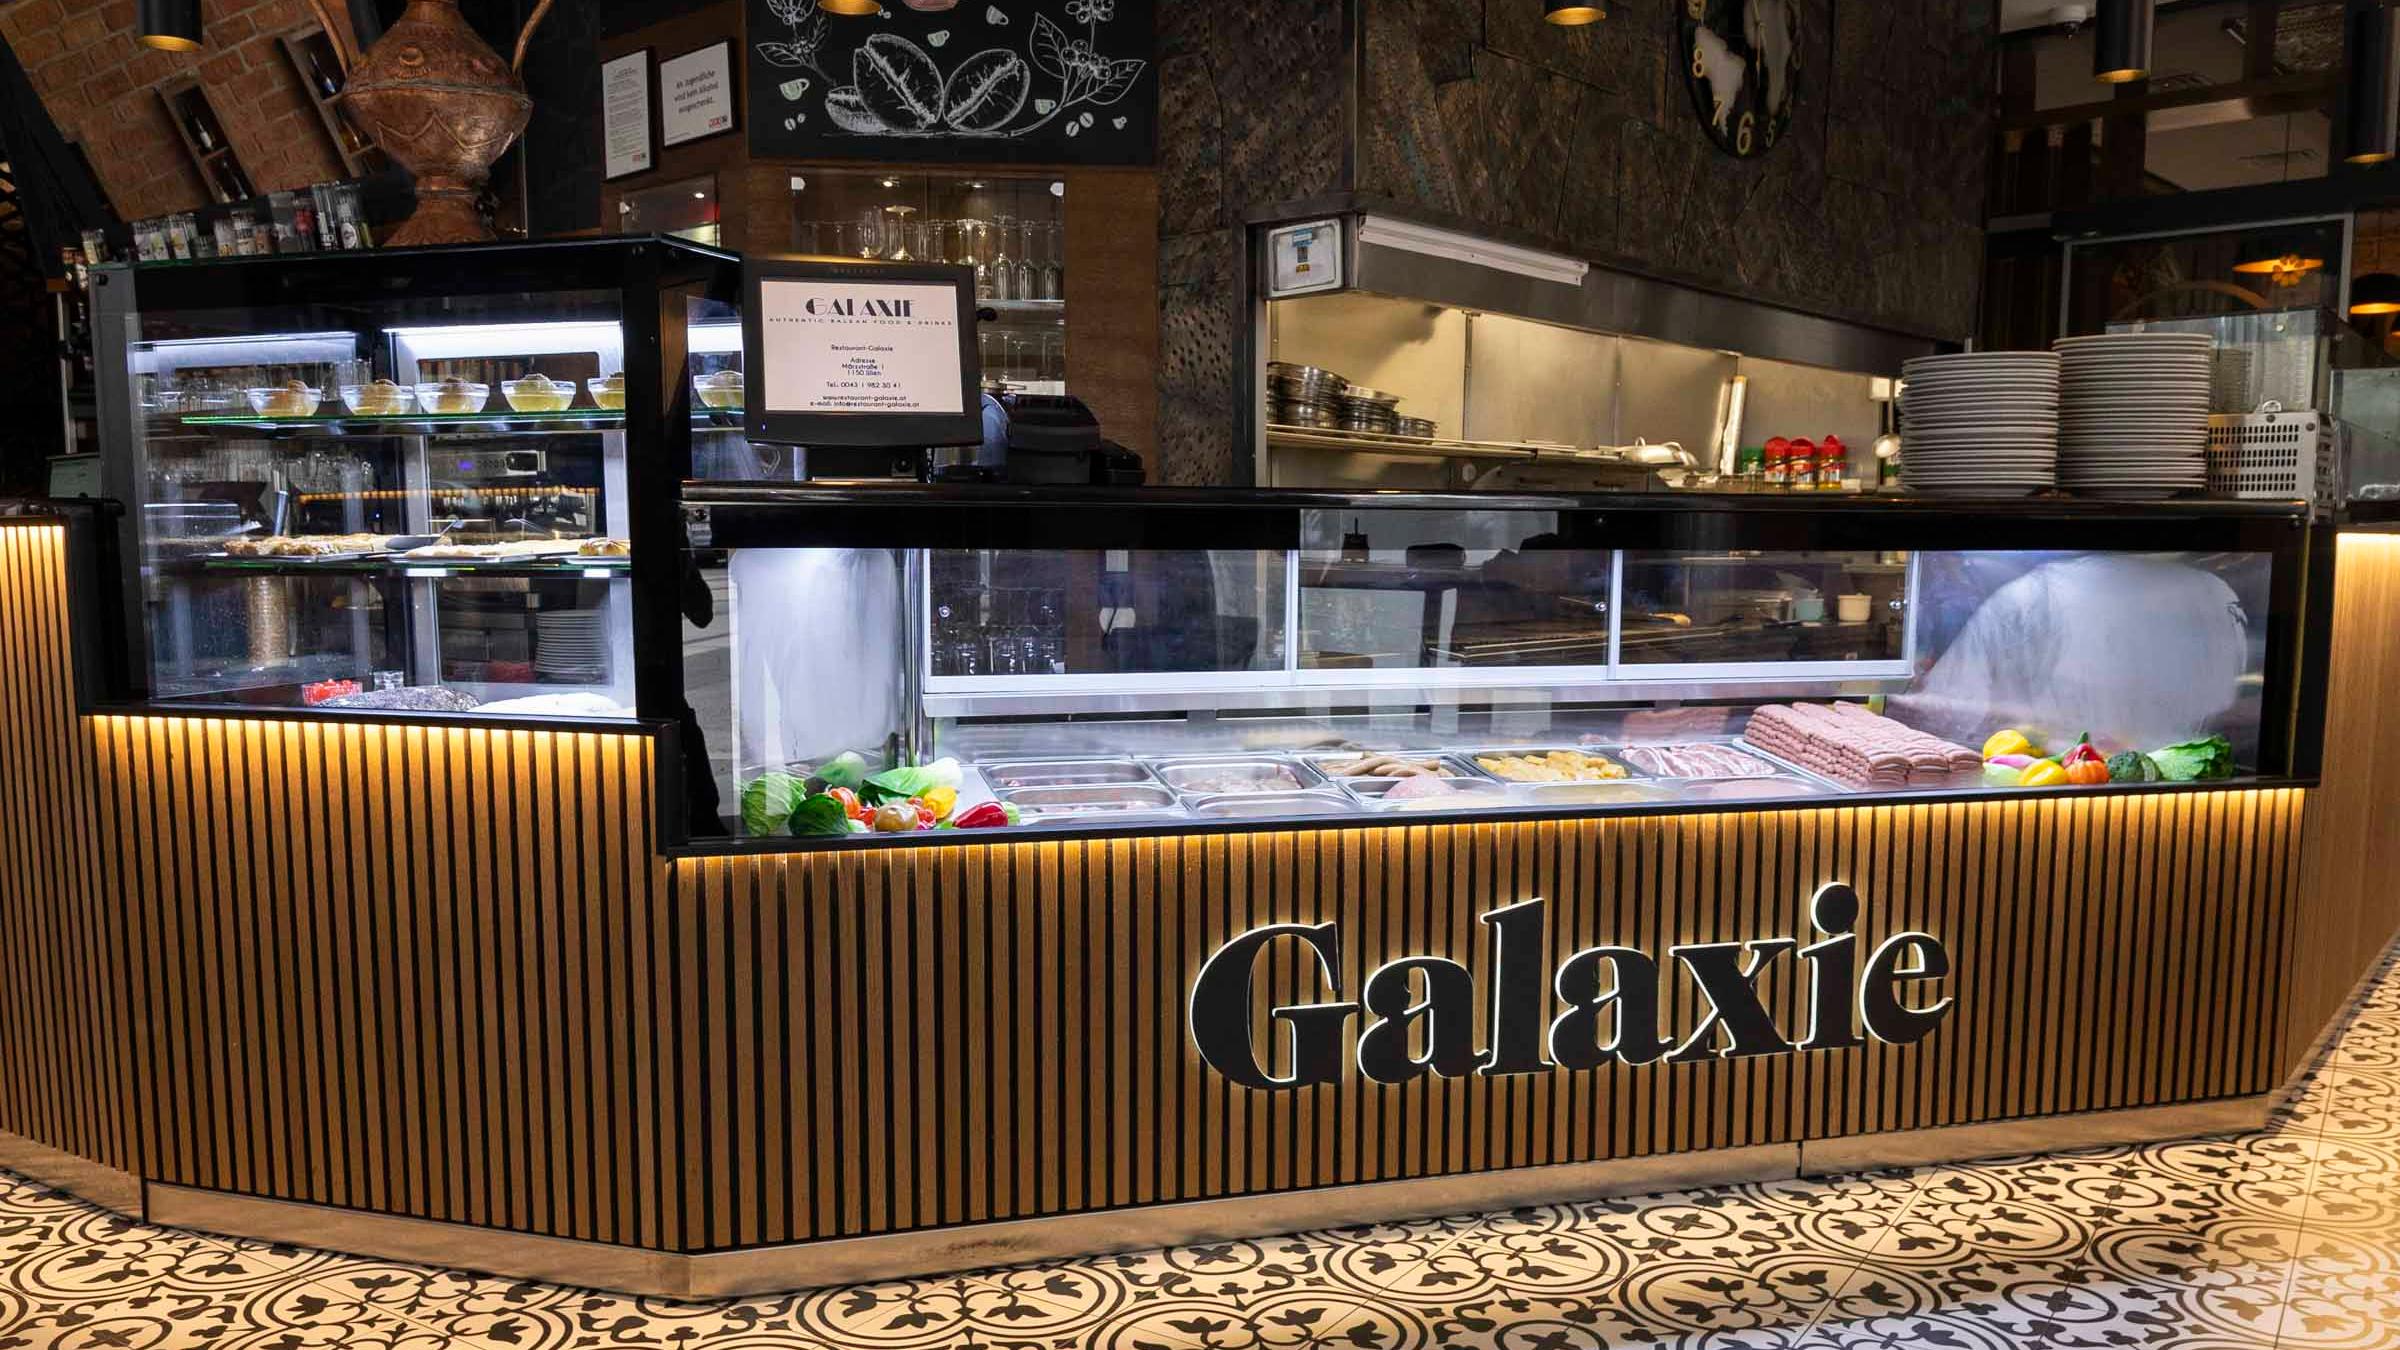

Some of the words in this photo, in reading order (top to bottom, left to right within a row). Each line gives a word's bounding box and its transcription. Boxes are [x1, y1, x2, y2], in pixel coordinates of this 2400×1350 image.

[1693, 46, 1705, 78] 8
[1712, 97, 1725, 126] 7
[1736, 110, 1755, 155] 6
[1765, 119, 1777, 148] 5
[1190, 881, 1955, 1091] Galaxie
